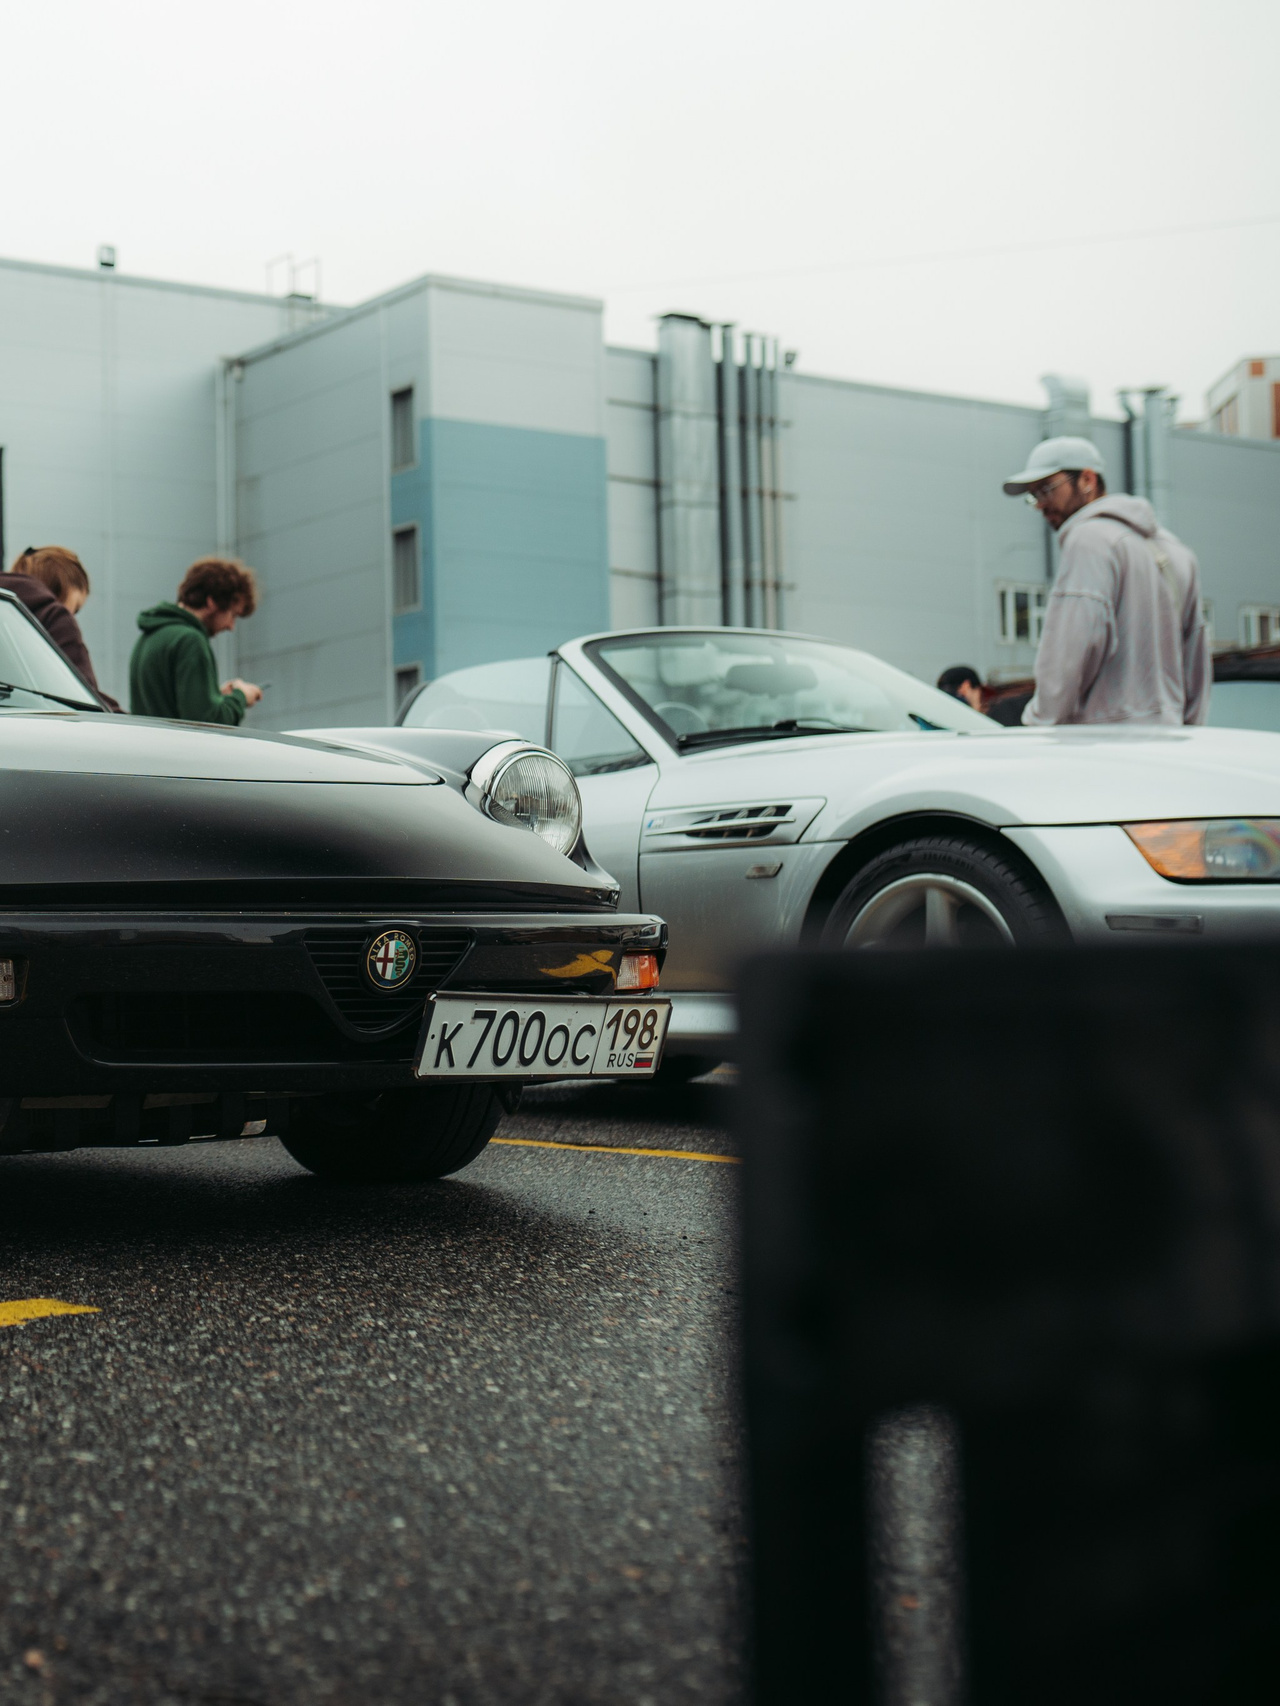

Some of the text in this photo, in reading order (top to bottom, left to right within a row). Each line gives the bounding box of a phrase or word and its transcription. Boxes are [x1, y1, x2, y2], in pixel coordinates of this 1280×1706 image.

[370, 933, 415, 961] ALFA ROMEO
[606, 1008, 659, 1051] 198
[606, 1052, 634, 1068] RUS
